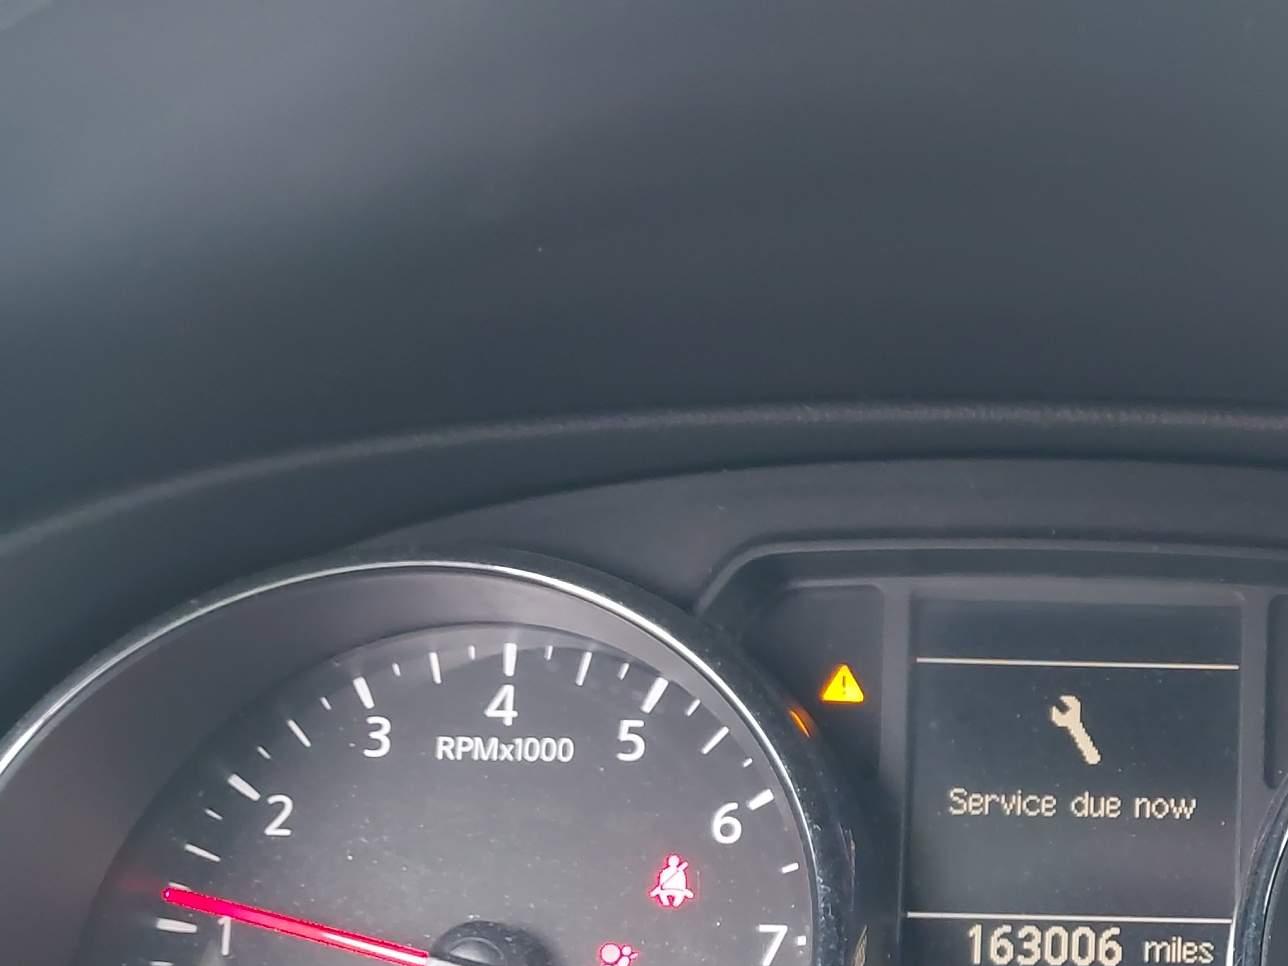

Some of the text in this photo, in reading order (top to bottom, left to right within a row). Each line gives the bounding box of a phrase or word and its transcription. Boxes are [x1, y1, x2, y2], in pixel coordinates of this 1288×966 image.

[485, 685, 518, 726] 4
[364, 717, 391, 757] 3
[436, 736, 574, 763] RPMx1000
[617, 720, 645, 761] 5
[264, 795, 292, 836] 2
[712, 803, 742, 844] 6
[949, 787, 1197, 820] Service due now
[218, 916, 231, 956] 1
[758, 925, 788, 966] 7
[968, 925, 1215, 966] 163006 miles
